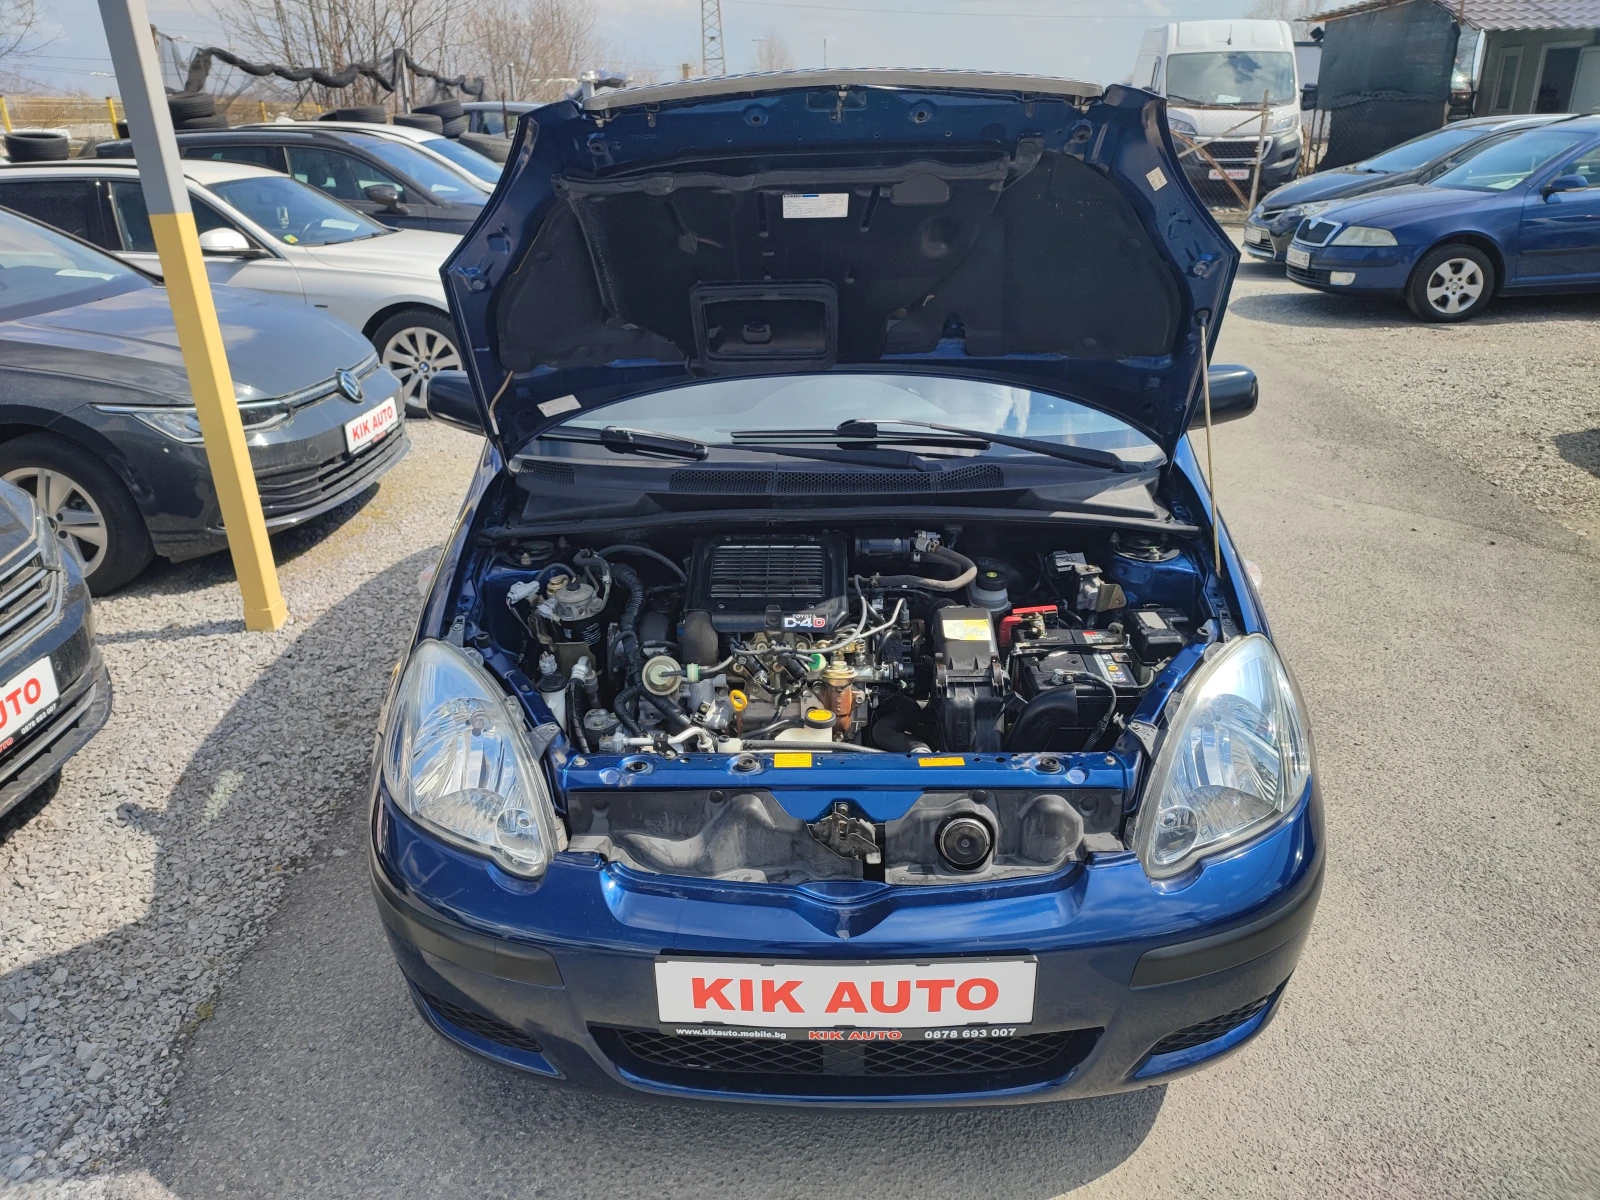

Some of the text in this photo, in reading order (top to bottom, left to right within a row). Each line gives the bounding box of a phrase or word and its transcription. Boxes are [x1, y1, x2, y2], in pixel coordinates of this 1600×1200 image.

[352, 420, 370, 441] KIK
[373, 406, 392, 429] AUTO
[784, 617, 826, 628] D-4D
[691, 977, 999, 1013] KIK AUTO
[676, 1028, 787, 1040] www.kikauto.mobile.bg
[808, 1030, 903, 1040] KIK AUTO
[924, 1028, 1017, 1039] 0878 693 007
